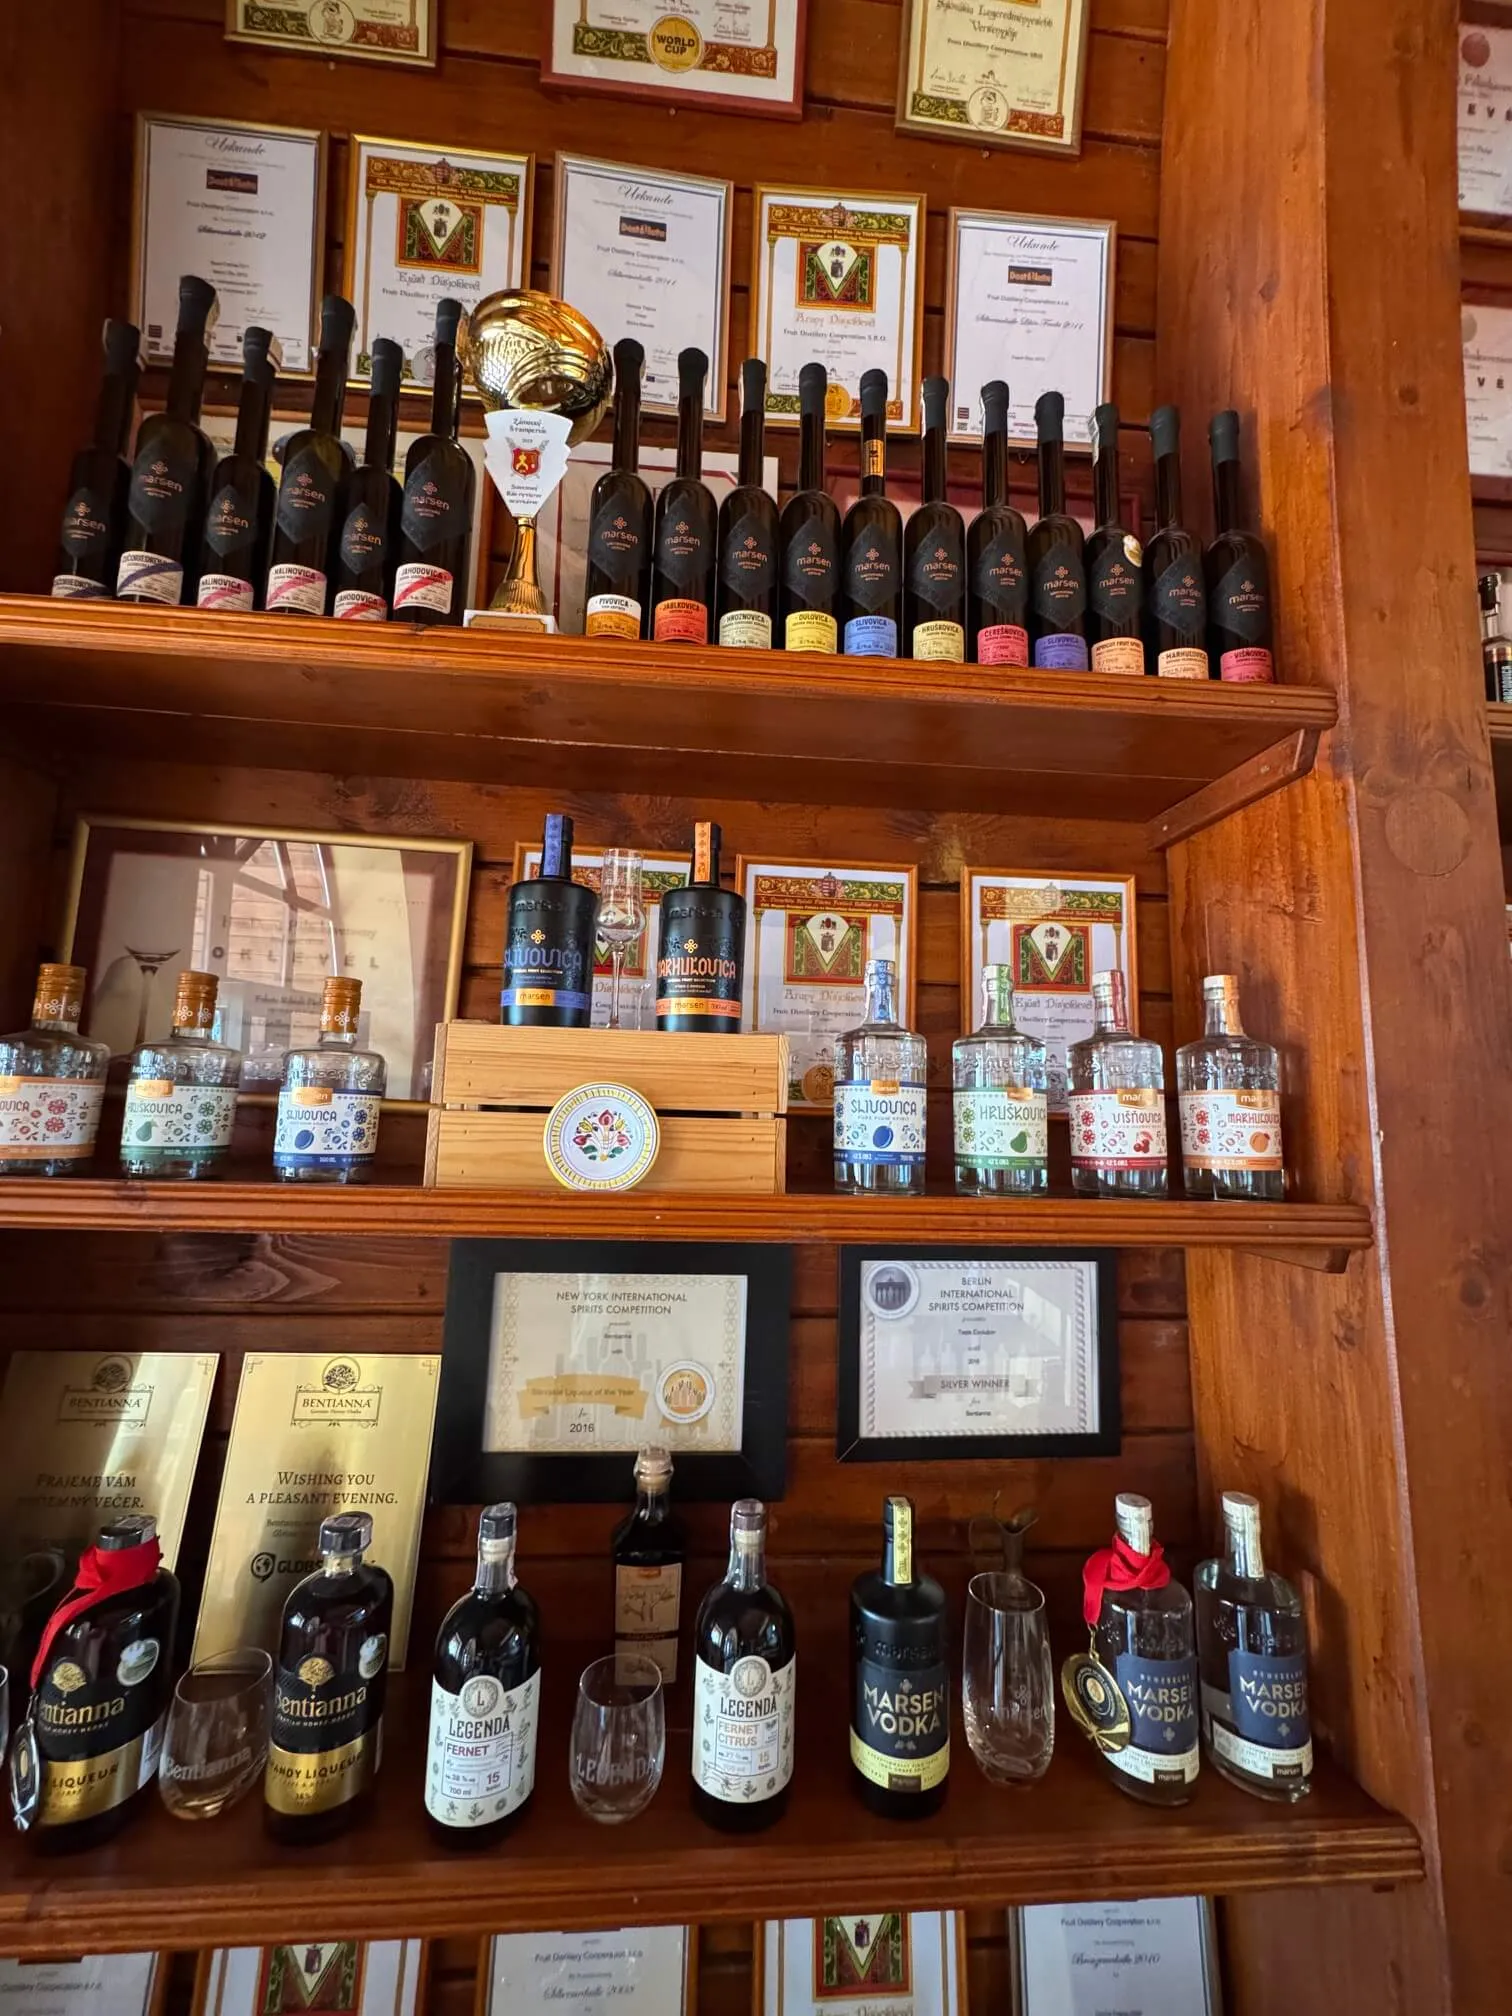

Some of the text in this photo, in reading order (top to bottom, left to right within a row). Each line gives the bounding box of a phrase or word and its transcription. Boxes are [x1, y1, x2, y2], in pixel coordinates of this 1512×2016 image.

[656, 34, 695, 48] WORLD
[664, 44, 687, 56] CUP
[617, 183, 674, 206] Urkunde
[1007, 234, 1060, 252] Urkunde
[286, 486, 326, 503] marsen
[410, 494, 450, 512] marsen
[601, 531, 639, 545] marsen
[665, 535, 701, 547] marsen
[732, 550, 768, 563] marsen
[796, 556, 832, 568] marsen
[273, 566, 317, 580] MALINOVICA
[401, 566, 443, 580] JAHODOVICA
[854, 563, 891, 573] marsen
[922, 562, 959, 573] marsen
[989, 567, 1024, 577] marsen
[1042, 579, 1079, 592] marsen
[1099, 576, 1135, 588] marsen
[662, 601, 701, 612] JABLKOVICA
[726, 613, 766, 625] HROZNOVICA
[855, 616, 888, 628] SLIVOVICA
[921, 622, 960, 635] HRUŠKOVICA
[519, 992, 551, 1001] marsen
[674, 1001, 705, 1009] marsen
[850, 1099, 917, 1117] SLIVOVICA
[286, 1108, 337, 1123] SLIVOVICA
[961, 1276, 992, 1287] BERLIN
[556, 1291, 687, 1302] NEW YORK INTERNATIONAL
[940, 1288, 1014, 1299] INTERNATIONAL
[570, 1304, 672, 1315] SPIRITS COMPETITION
[928, 1301, 1025, 1312] SPIRITS COMPETITION
[940, 1379, 1010, 1390] SILVER WINNER
[594, 1388, 602, 1396] of
[604, 1388, 615, 1396] the
[617, 1388, 635, 1396] Year
[569, 1422, 595, 1433] 2016
[105, 1472, 136, 1488] VÁM
[94, 1494, 144, 1509] VEČER.
[246, 1493, 255, 1505] A
[259, 1492, 330, 1505] PLEASANT
[275, 1684, 367, 1718] Bentianna
[477, 1691, 485, 1706] L
[863, 1679, 945, 1714] MARSEN
[719, 1695, 777, 1719] LEGENDA
[1132, 1700, 1194, 1723] VODKA
[1245, 1695, 1308, 1718] VODKA
[449, 1716, 511, 1739] LEGENDA
[718, 1721, 761, 1735] FERNET
[866, 1709, 940, 1737] VODKA
[718, 1732, 757, 1747] CITRUS
[446, 1743, 490, 1757] FERNET
[760, 1751, 769, 1763] 15
[52, 1762, 119, 1788] LIQUEUR
[487, 1770, 500, 1785] 15
[1077, 1917, 1104, 1928] Distillery
[1106, 1917, 1146, 1928] Cooperation
